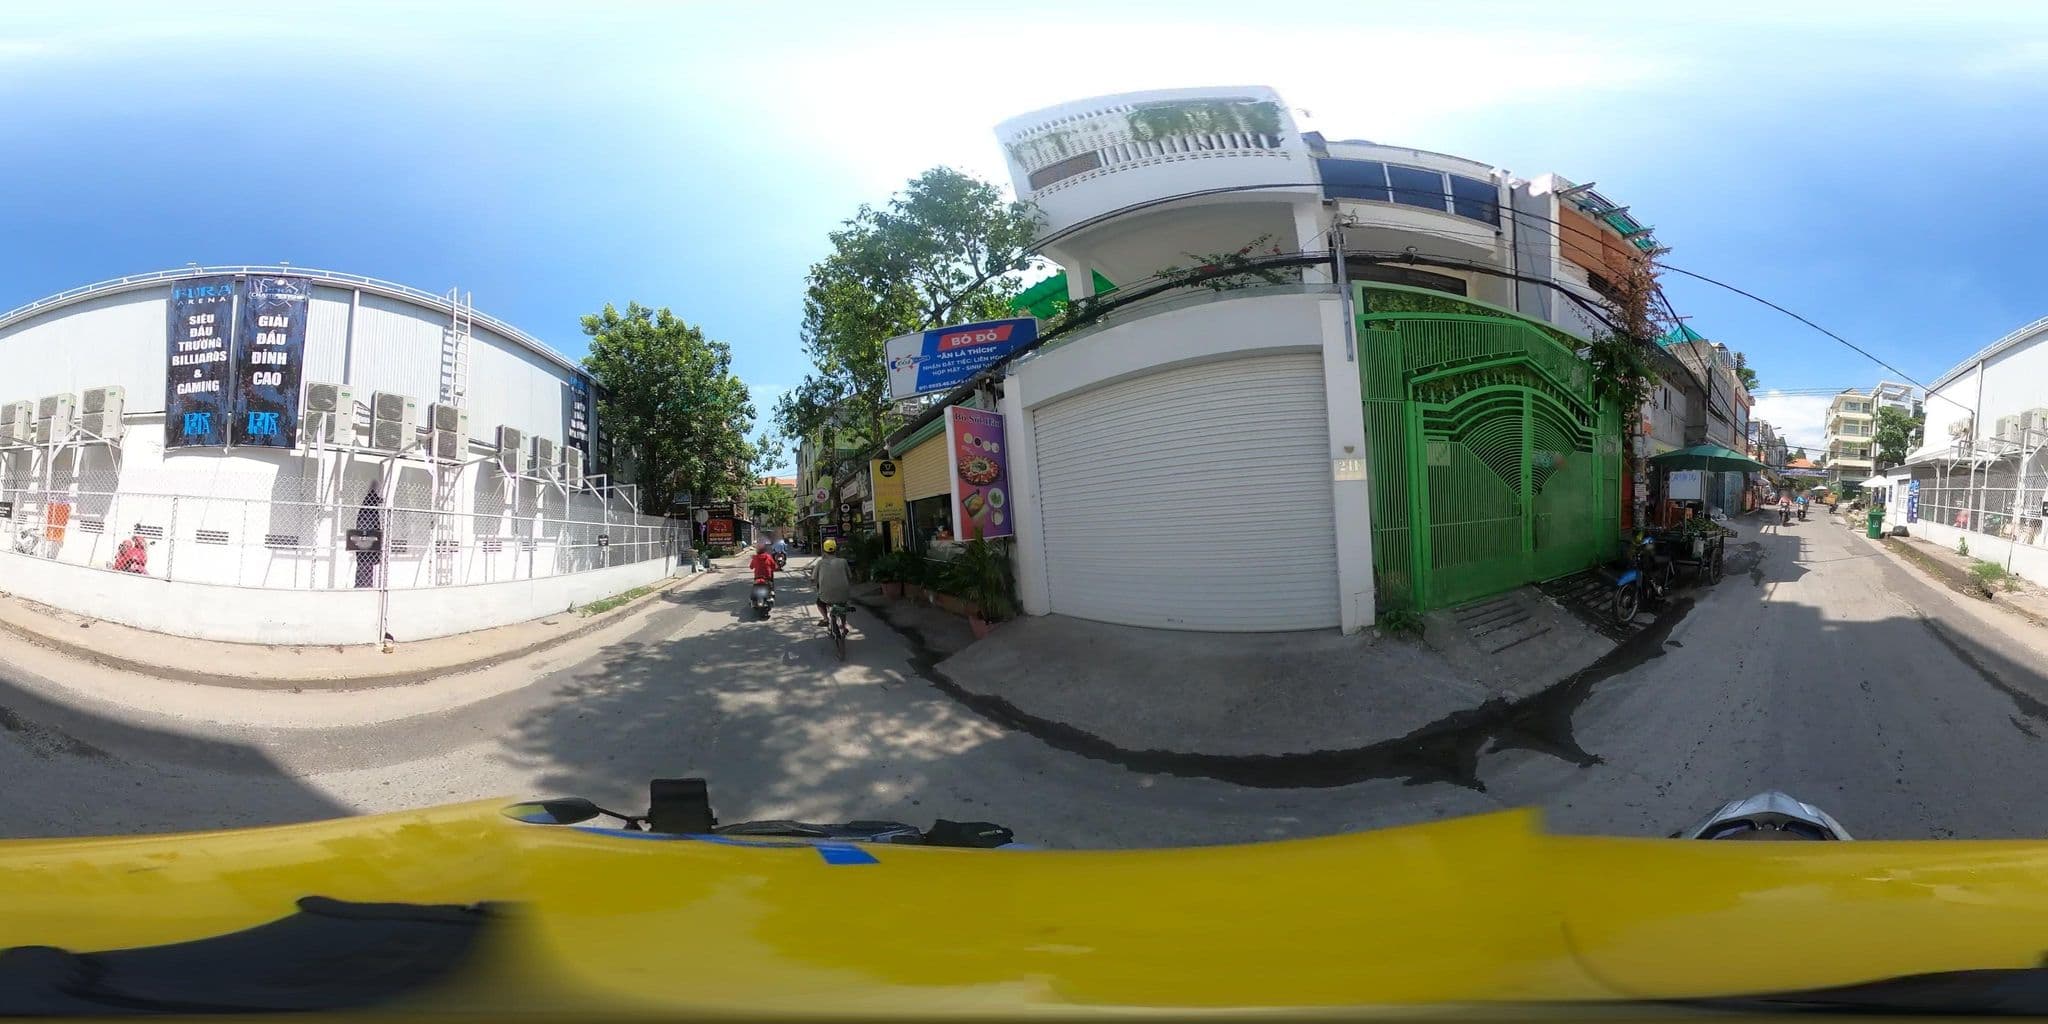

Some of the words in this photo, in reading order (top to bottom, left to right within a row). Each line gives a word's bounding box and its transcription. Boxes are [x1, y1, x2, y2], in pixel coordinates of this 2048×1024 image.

[189, 313, 215, 326] SIÊU
[172, 350, 228, 366] BILLIARDS
[193, 369, 203, 379] &
[252, 371, 282, 386] CAO
[177, 380, 220, 395] GAMING
